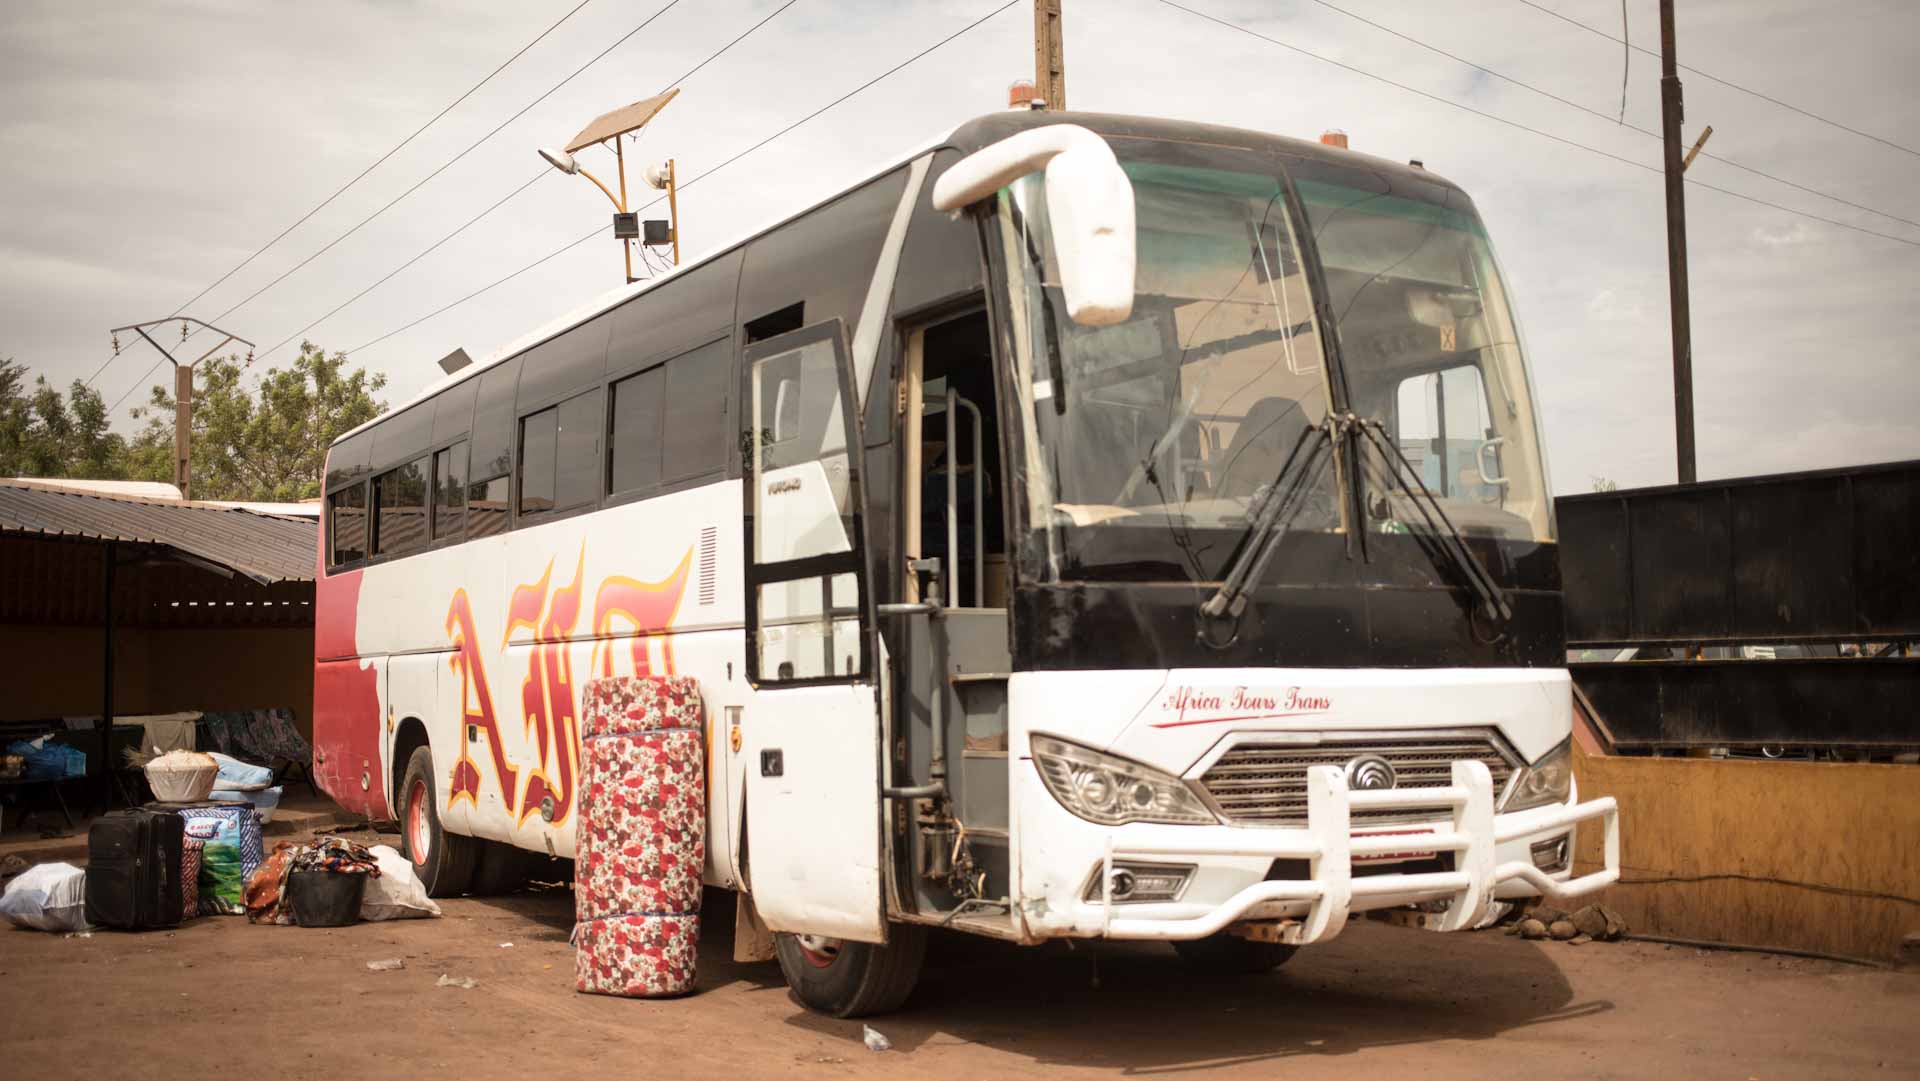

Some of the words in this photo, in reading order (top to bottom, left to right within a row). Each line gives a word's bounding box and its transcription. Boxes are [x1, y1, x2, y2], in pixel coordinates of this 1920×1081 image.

[1162, 686, 1221, 720] Africa
[1231, 686, 1276, 710] Tours
[1284, 686, 1330, 710] Trans
